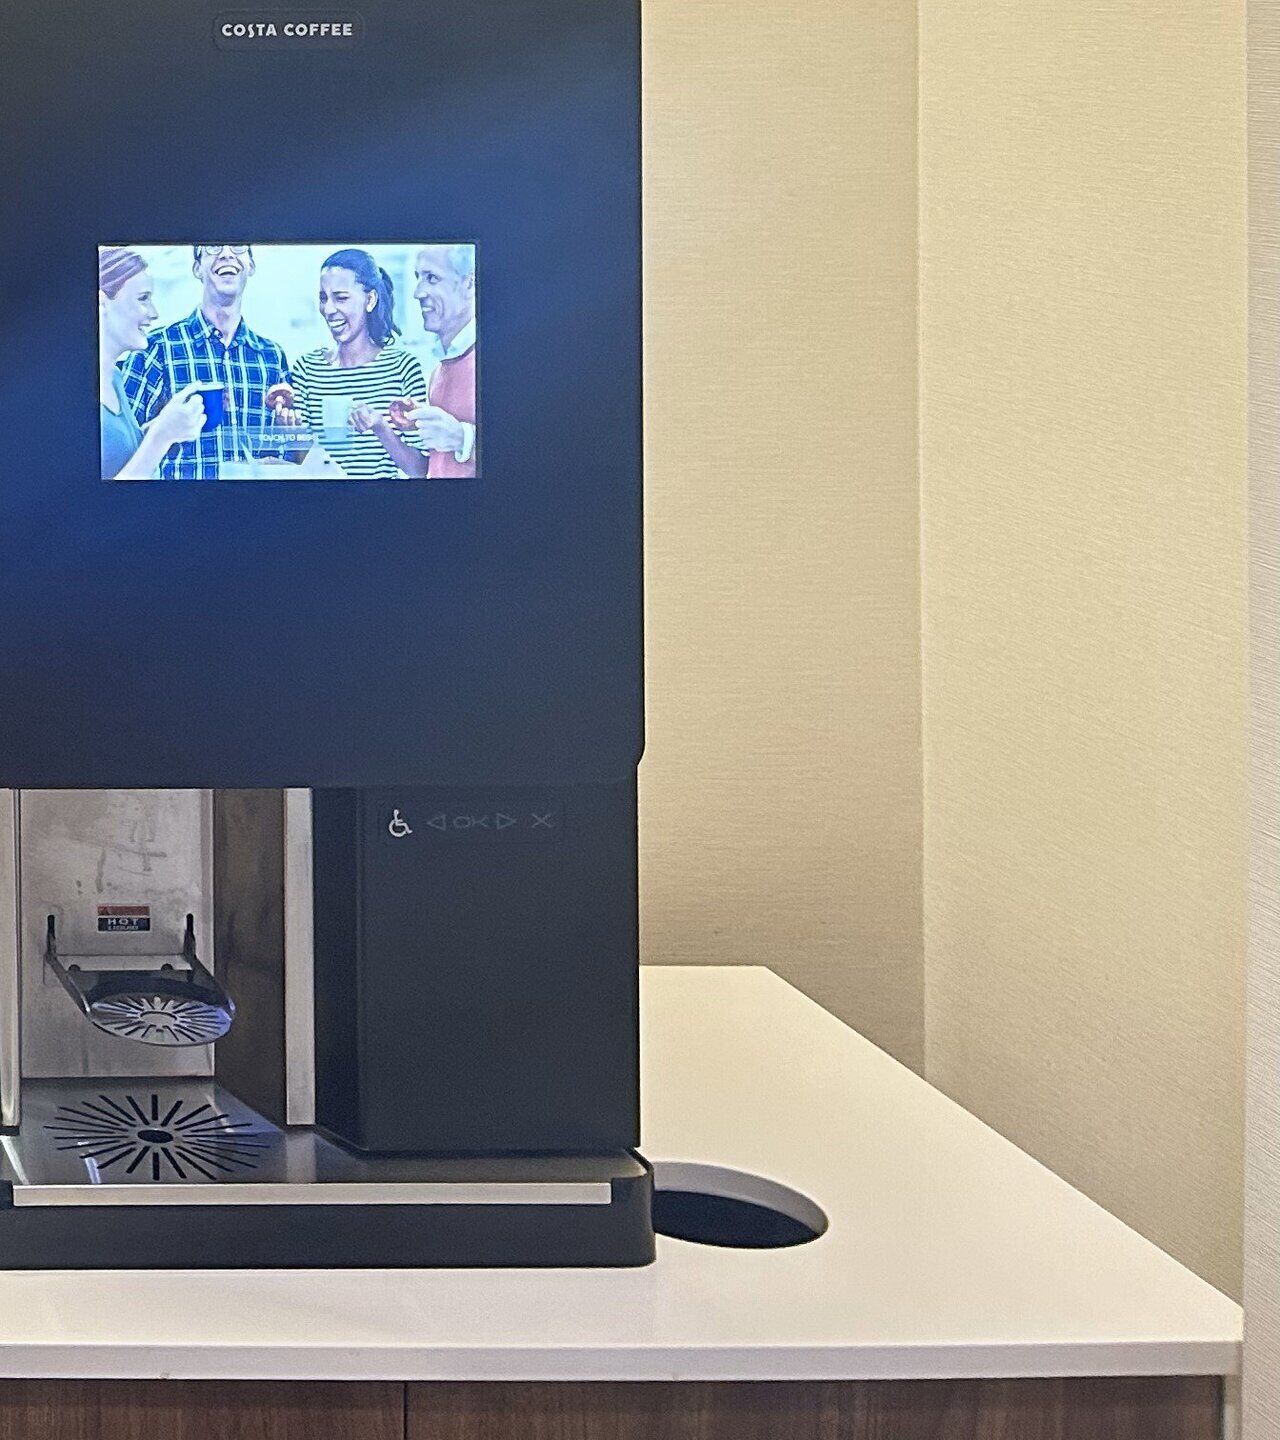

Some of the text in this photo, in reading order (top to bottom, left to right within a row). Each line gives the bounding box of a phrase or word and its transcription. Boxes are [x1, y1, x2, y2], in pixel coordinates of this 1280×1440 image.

[221, 23, 353, 38] COSTA COFFEE
[107, 918, 139, 926] HOT
